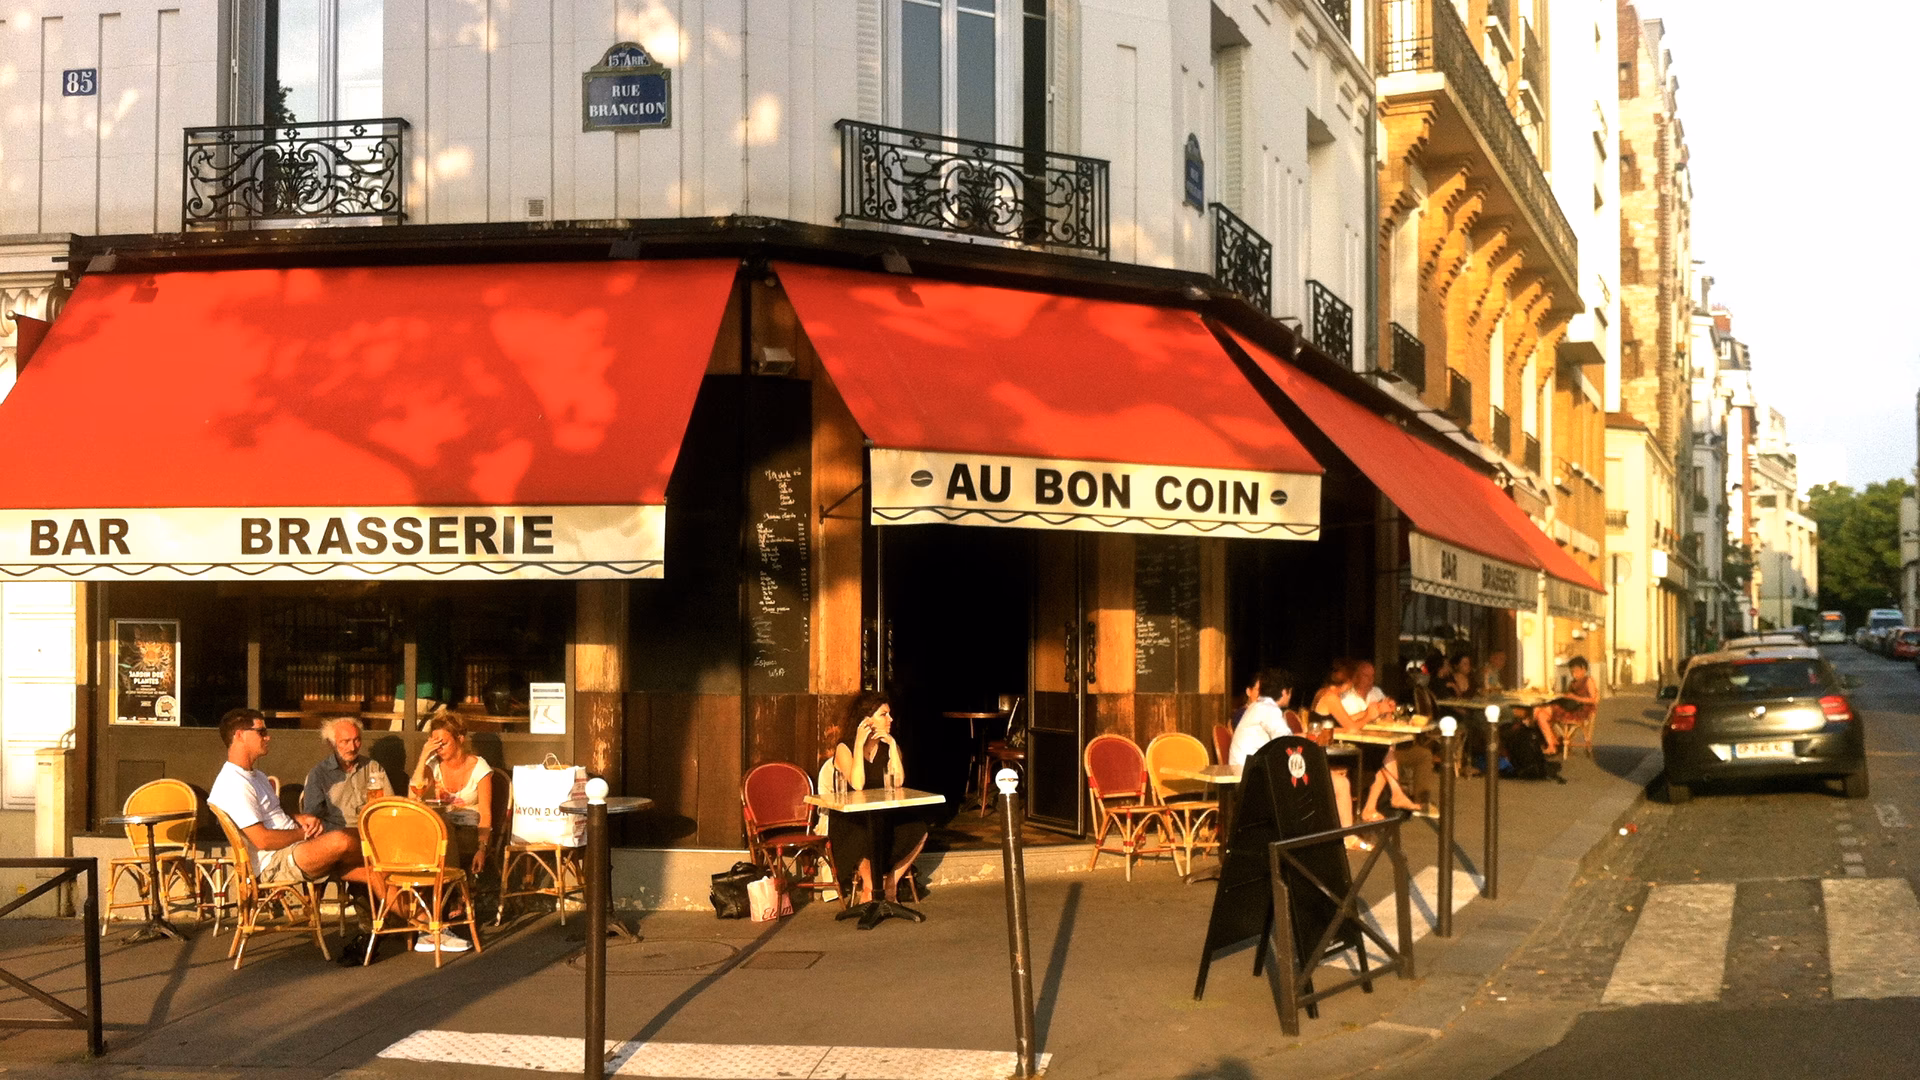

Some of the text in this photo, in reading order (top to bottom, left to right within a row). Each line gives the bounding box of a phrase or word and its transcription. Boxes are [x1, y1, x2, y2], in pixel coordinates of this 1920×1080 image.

[66, 71, 94, 94] 85
[612, 84, 640, 97] RUE
[589, 102, 665, 117] BRANCION
[946, 463, 1259, 516] AU BON COIN
[29, 514, 555, 556] BAR BRASSERIE
